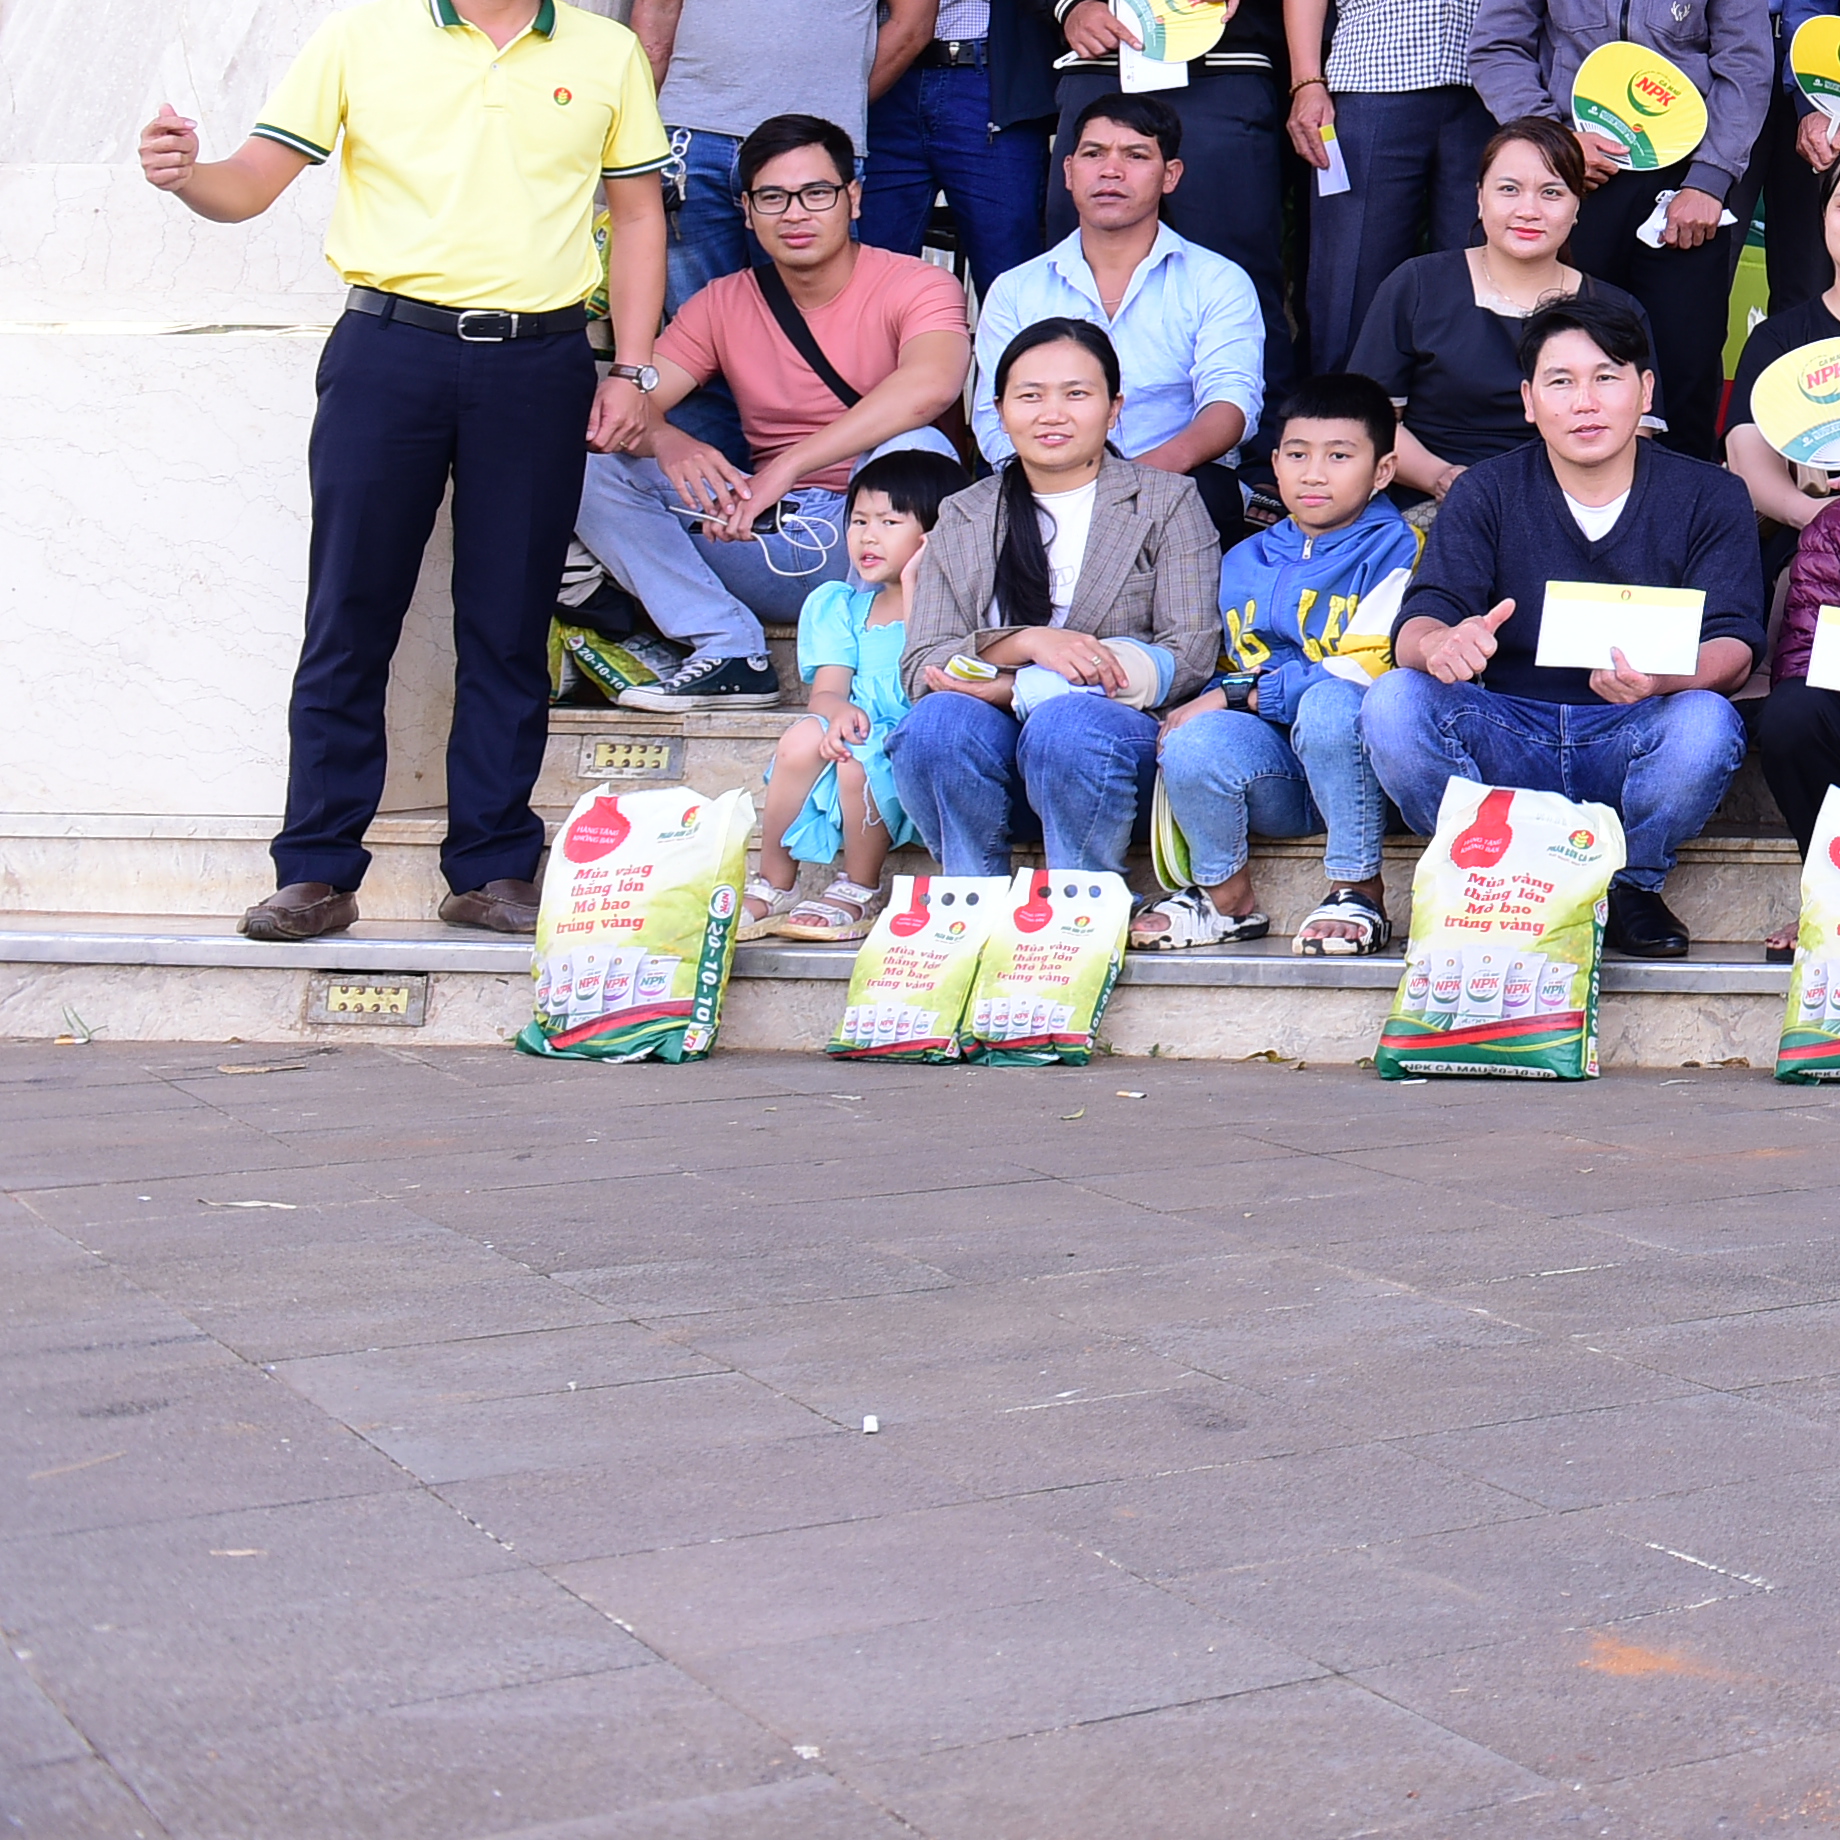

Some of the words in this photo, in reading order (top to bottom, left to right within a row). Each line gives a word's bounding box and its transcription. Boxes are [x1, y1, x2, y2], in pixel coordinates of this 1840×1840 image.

[1635, 76, 1676, 108] NPK
[615, 864, 653, 877] vàng
[618, 880, 644, 892] lớn
[1512, 873, 1555, 893] vàng
[601, 898, 630, 910] bao
[1517, 889, 1546, 904] lớn
[1499, 904, 1532, 915] bao
[556, 918, 594, 934] trúng
[601, 914, 645, 931] vàng
[1444, 915, 1492, 932] trúng
[1500, 917, 1545, 936] vàng
[696, 922, 724, 1023] 20-10-10
[1470, 977, 1498, 989] NPK
